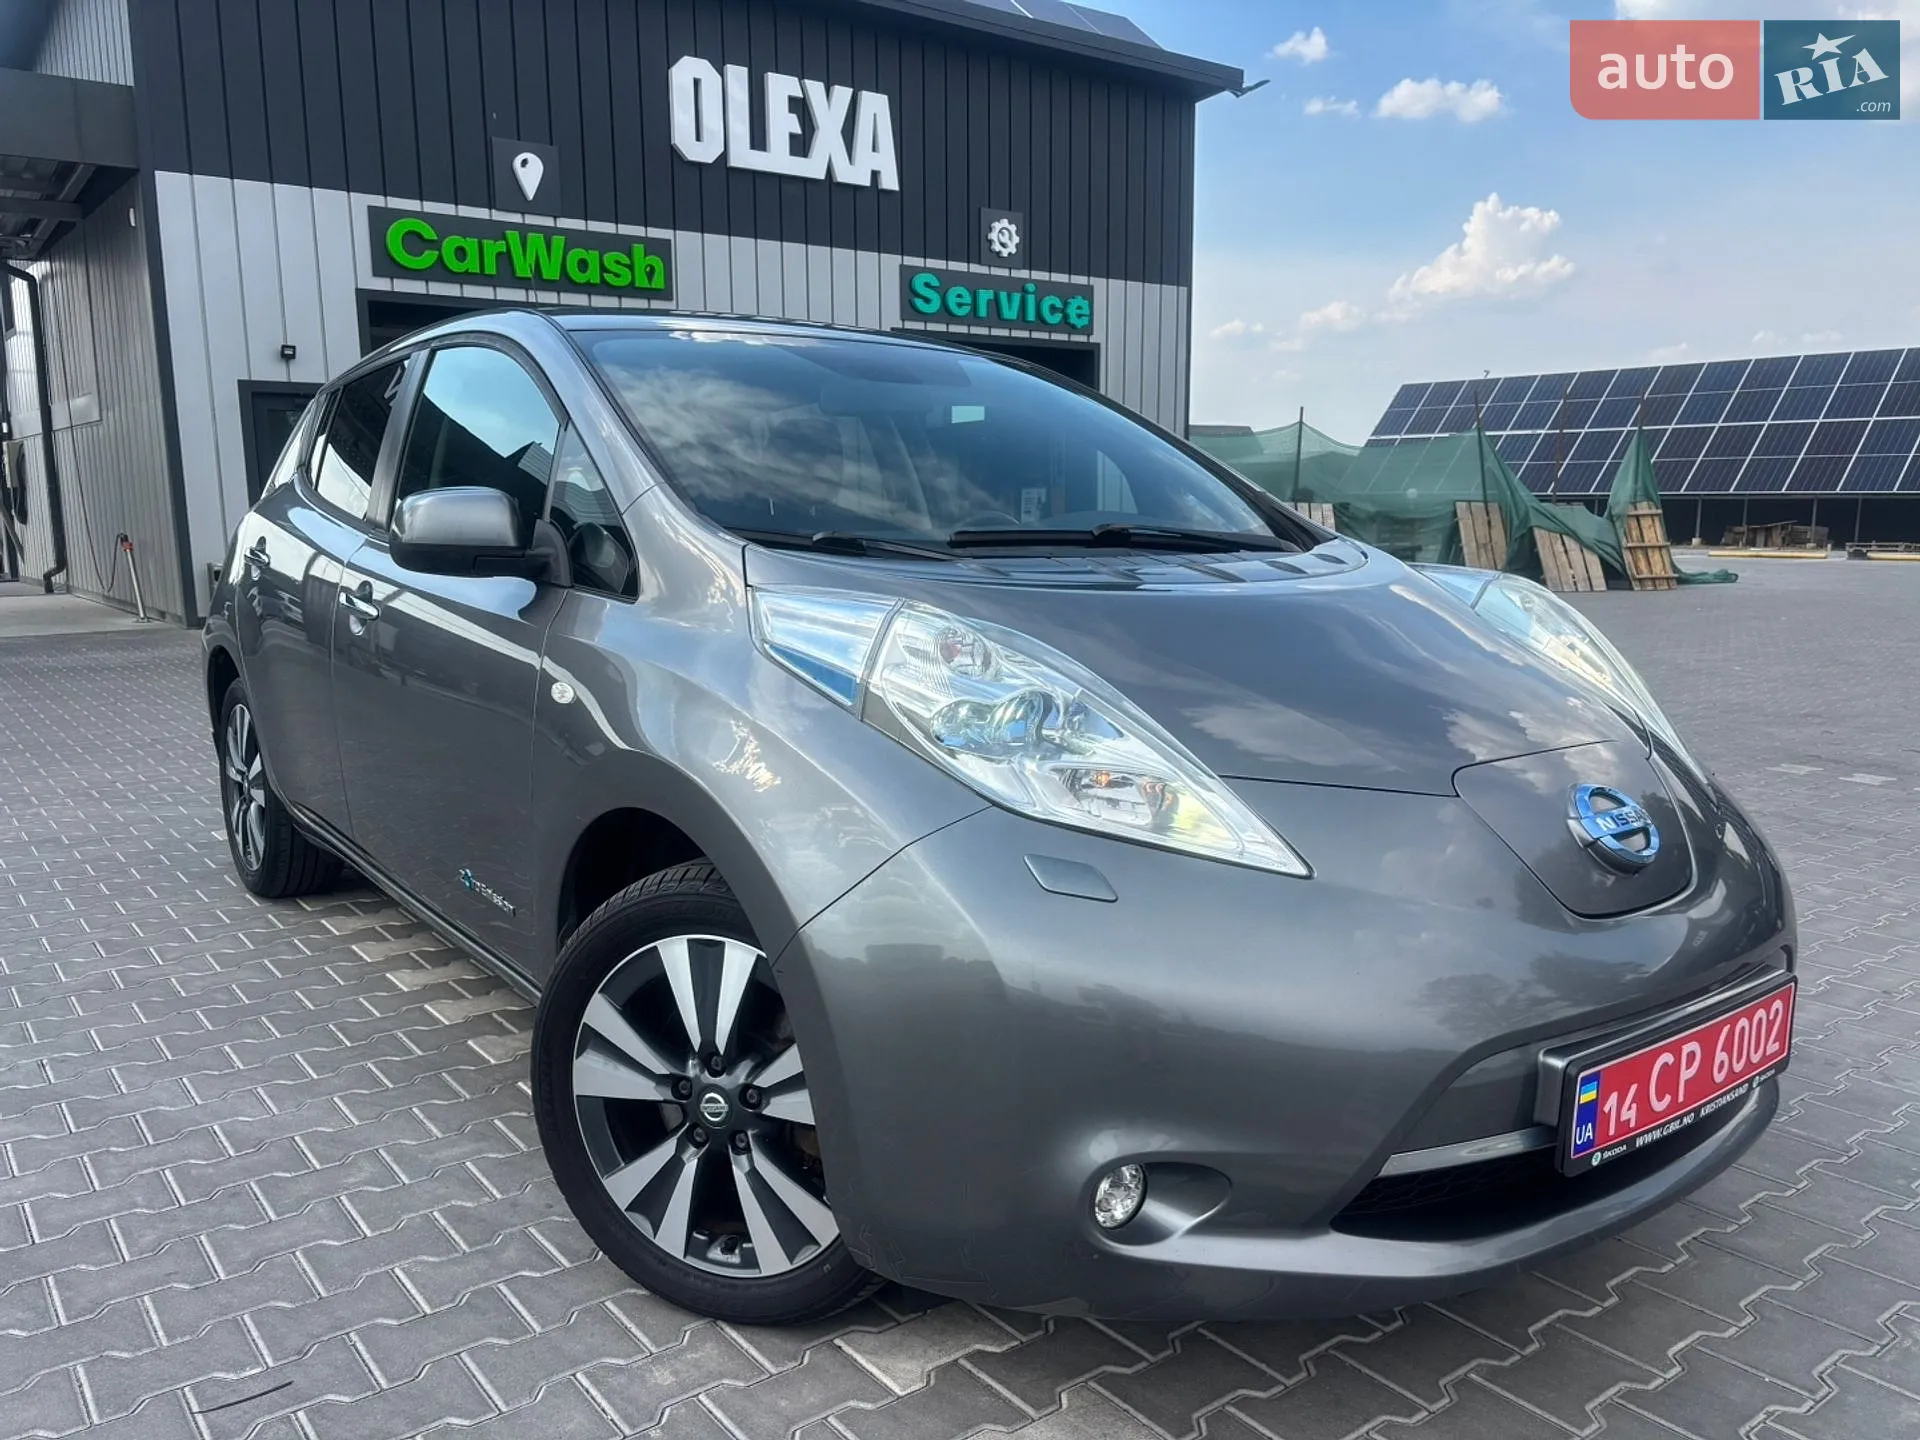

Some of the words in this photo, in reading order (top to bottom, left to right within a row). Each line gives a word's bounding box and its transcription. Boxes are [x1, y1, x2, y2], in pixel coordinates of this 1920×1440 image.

[668, 55, 900, 192] OLEXA
[385, 217, 666, 291] CarWash
[909, 272, 1091, 329] Service
[1603, 1083, 1637, 1135] 14
[1649, 1041, 1701, 1113] CP
[1713, 999, 1784, 1083] 6002
[1576, 1123, 1593, 1145] UA
